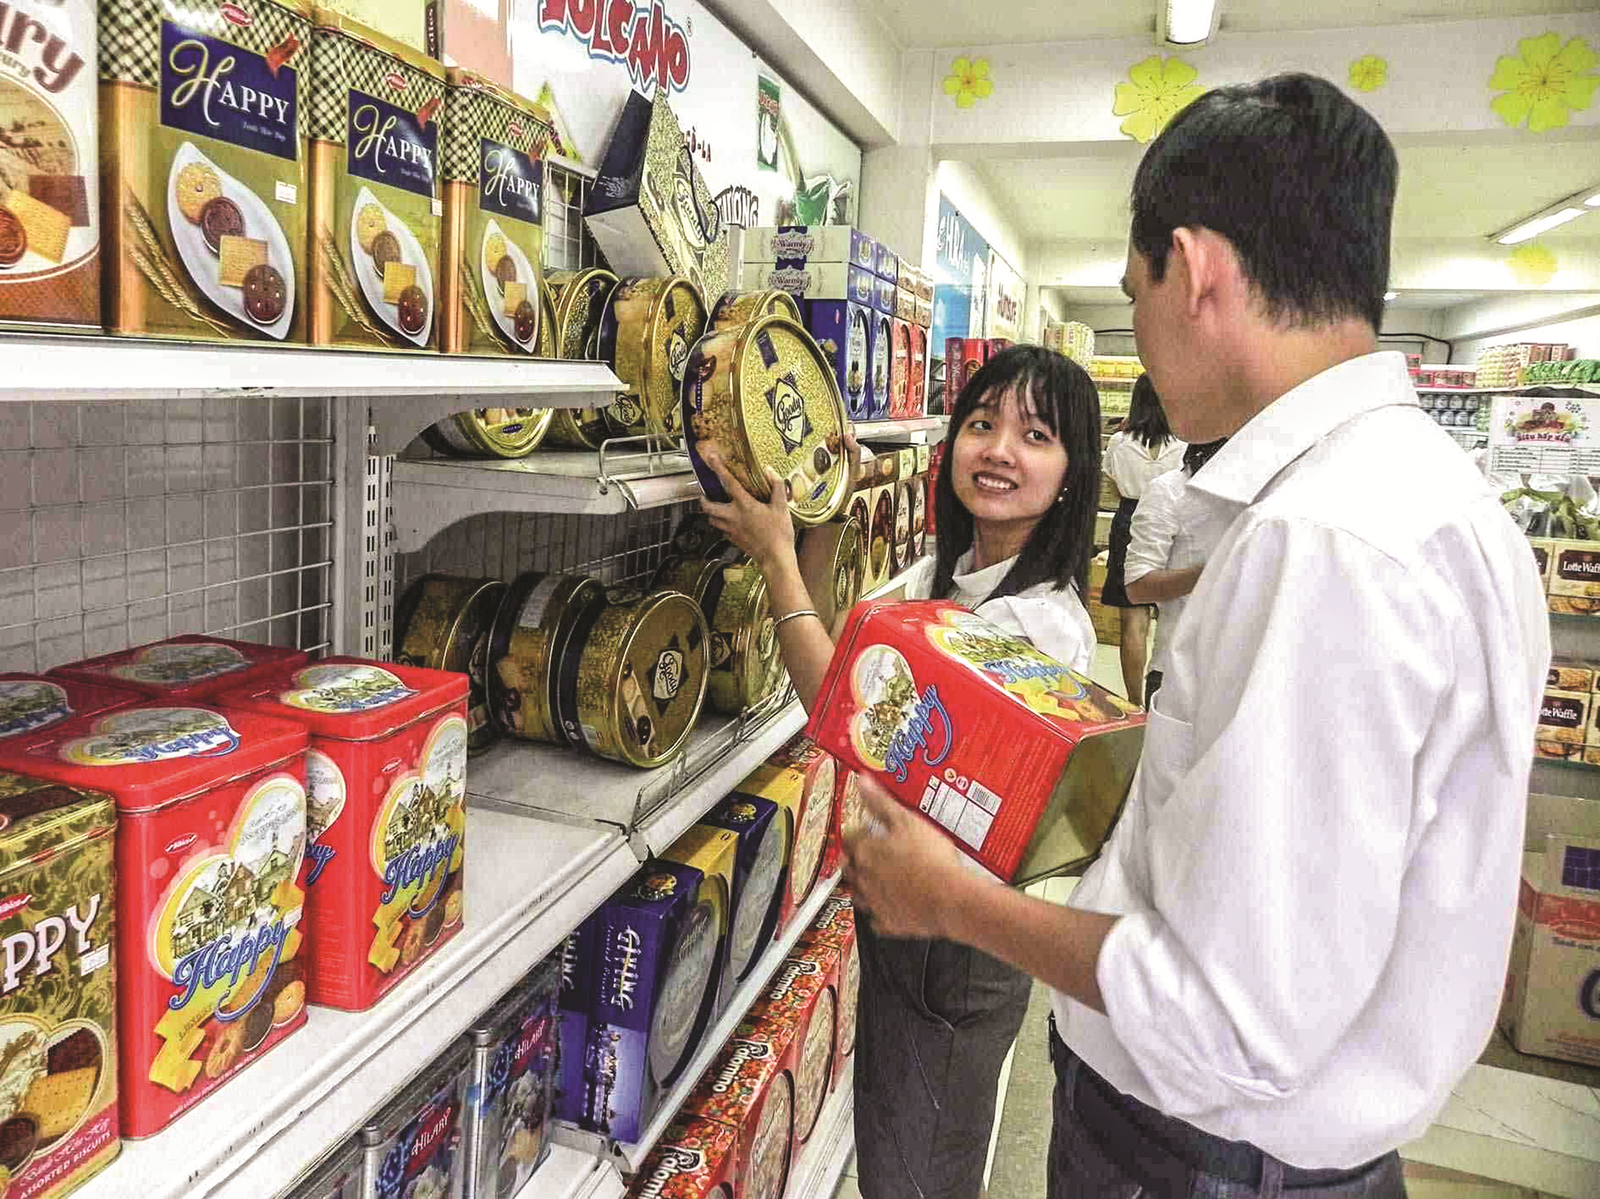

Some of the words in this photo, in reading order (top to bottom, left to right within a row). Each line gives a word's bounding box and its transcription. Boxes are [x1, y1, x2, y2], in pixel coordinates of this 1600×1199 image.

[0, 0, 86, 93] ry
[169, 39, 290, 126] HAPPY
[353, 104, 433, 173] HAPPY
[485, 149, 541, 207] HAPPY
[1563, 561, 1582, 572] Lotte
[884, 684, 953, 783] Happy
[1552, 708, 1578, 720] Waffle
[381, 833, 460, 921] Happy
[168, 920, 289, 1022] Happy
[610, 925, 642, 1012] GIVING
[770, 957, 819, 1000] Palomino
[711, 1037, 771, 1093] Palomino
[20, 1160, 71, 1199] ASSORTED
[73, 1131, 111, 1163] BISCUITS
